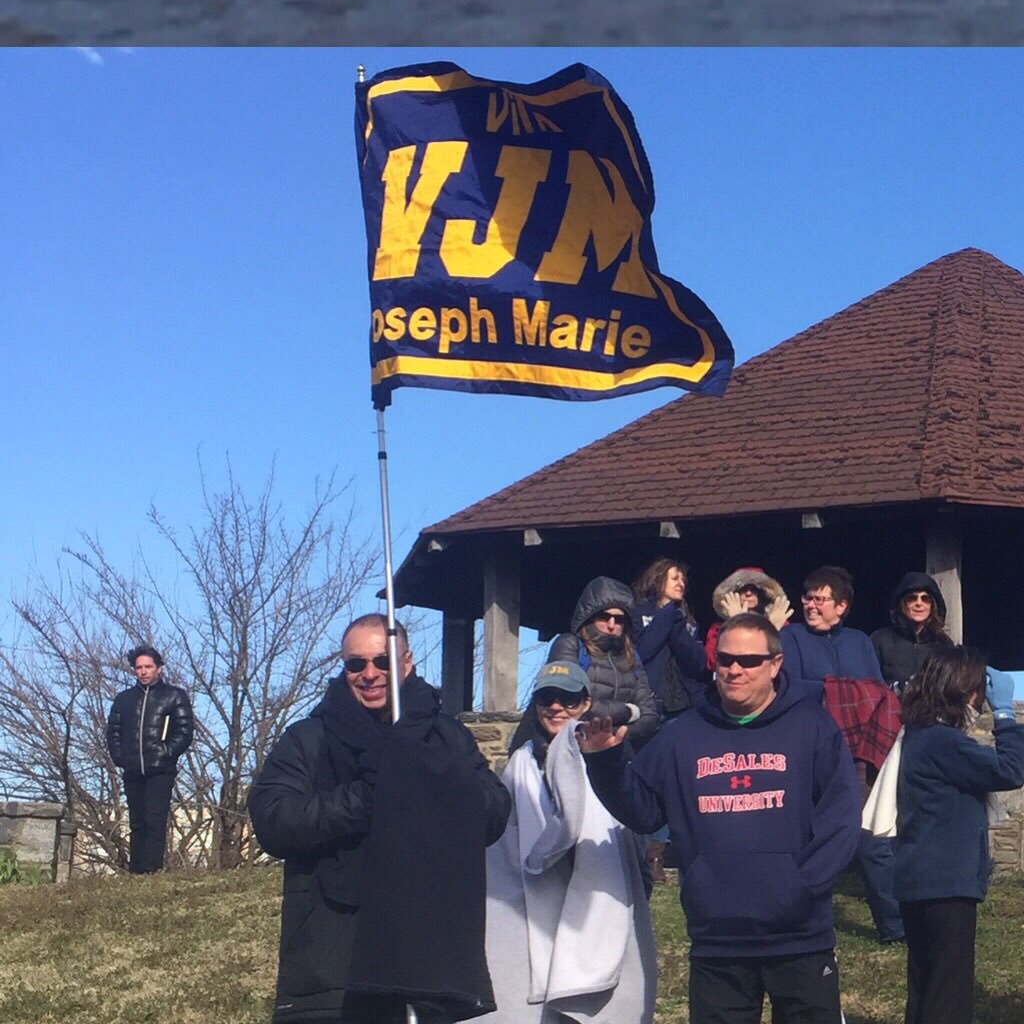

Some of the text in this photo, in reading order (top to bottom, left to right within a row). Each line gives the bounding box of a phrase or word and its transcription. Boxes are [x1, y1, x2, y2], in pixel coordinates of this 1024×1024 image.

[372, 141, 658, 299] VJM
[372, 297, 652, 358] oseph Marie
[698, 790, 786, 813] UNIVERSITY
